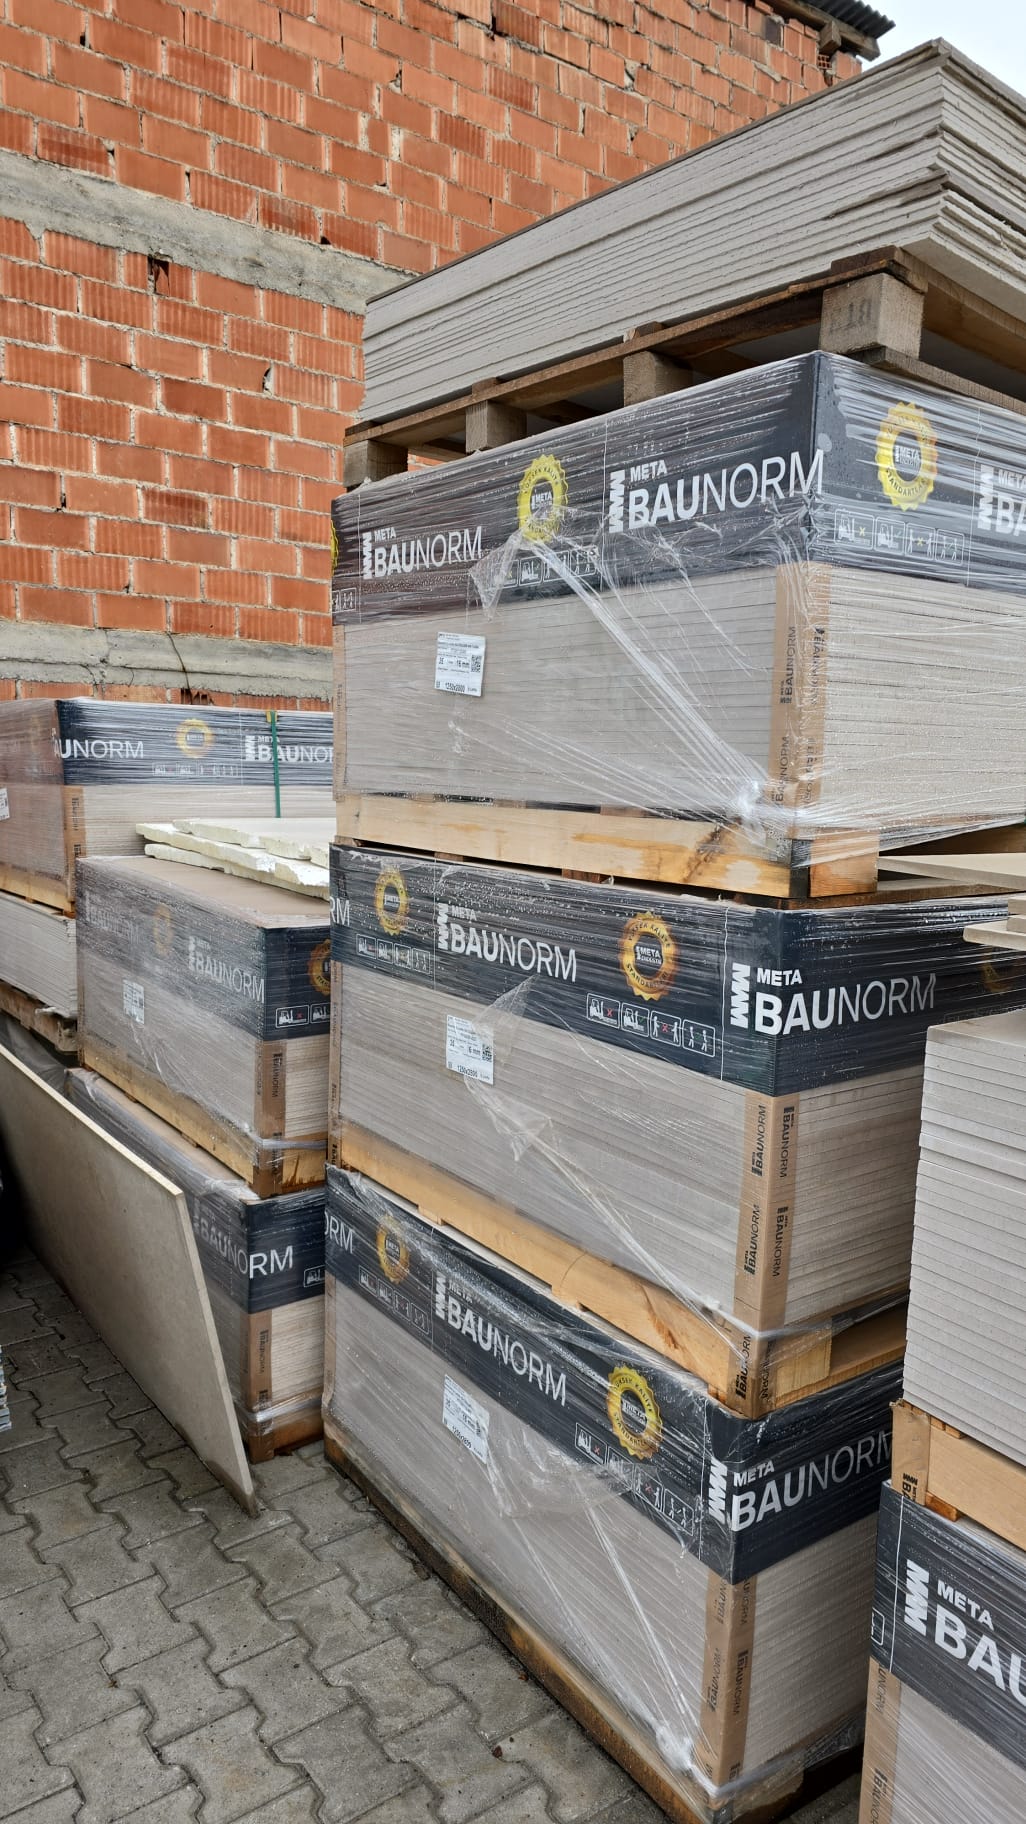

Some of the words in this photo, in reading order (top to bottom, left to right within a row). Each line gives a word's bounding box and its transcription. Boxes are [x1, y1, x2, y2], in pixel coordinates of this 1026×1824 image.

[535, 491, 553, 502] META
[628, 449, 824, 530] BAUNORM
[629, 459, 668, 482] META
[373, 527, 397, 541] META
[374, 525, 484, 578] BAUNORM
[54, 738, 144, 759] AUNORM
[257, 744, 334, 763] BAUNO
[451, 906, 477, 922] META
[195, 950, 265, 1004] BAUNORM
[450, 925, 578, 983] BAUNORM
[639, 946, 661, 959] META
[756, 967, 803, 987] META
[754, 972, 937, 1036] BAUNORM
[755, 1104, 766, 1169] BAUNORM
[779, 1114, 791, 1178] BAUNORM
[199, 1217, 294, 1280] BAUNORM
[748, 1204, 760, 1268] BAUNORM
[772, 1215, 785, 1277] BAUNORM
[447, 1294, 568, 1408] BAUNORM
[731, 1430, 892, 1532] BAUNORM
[733, 1459, 776, 1488] META
[936, 1579, 995, 1632] META
[934, 1603, 1026, 1708] BAU
